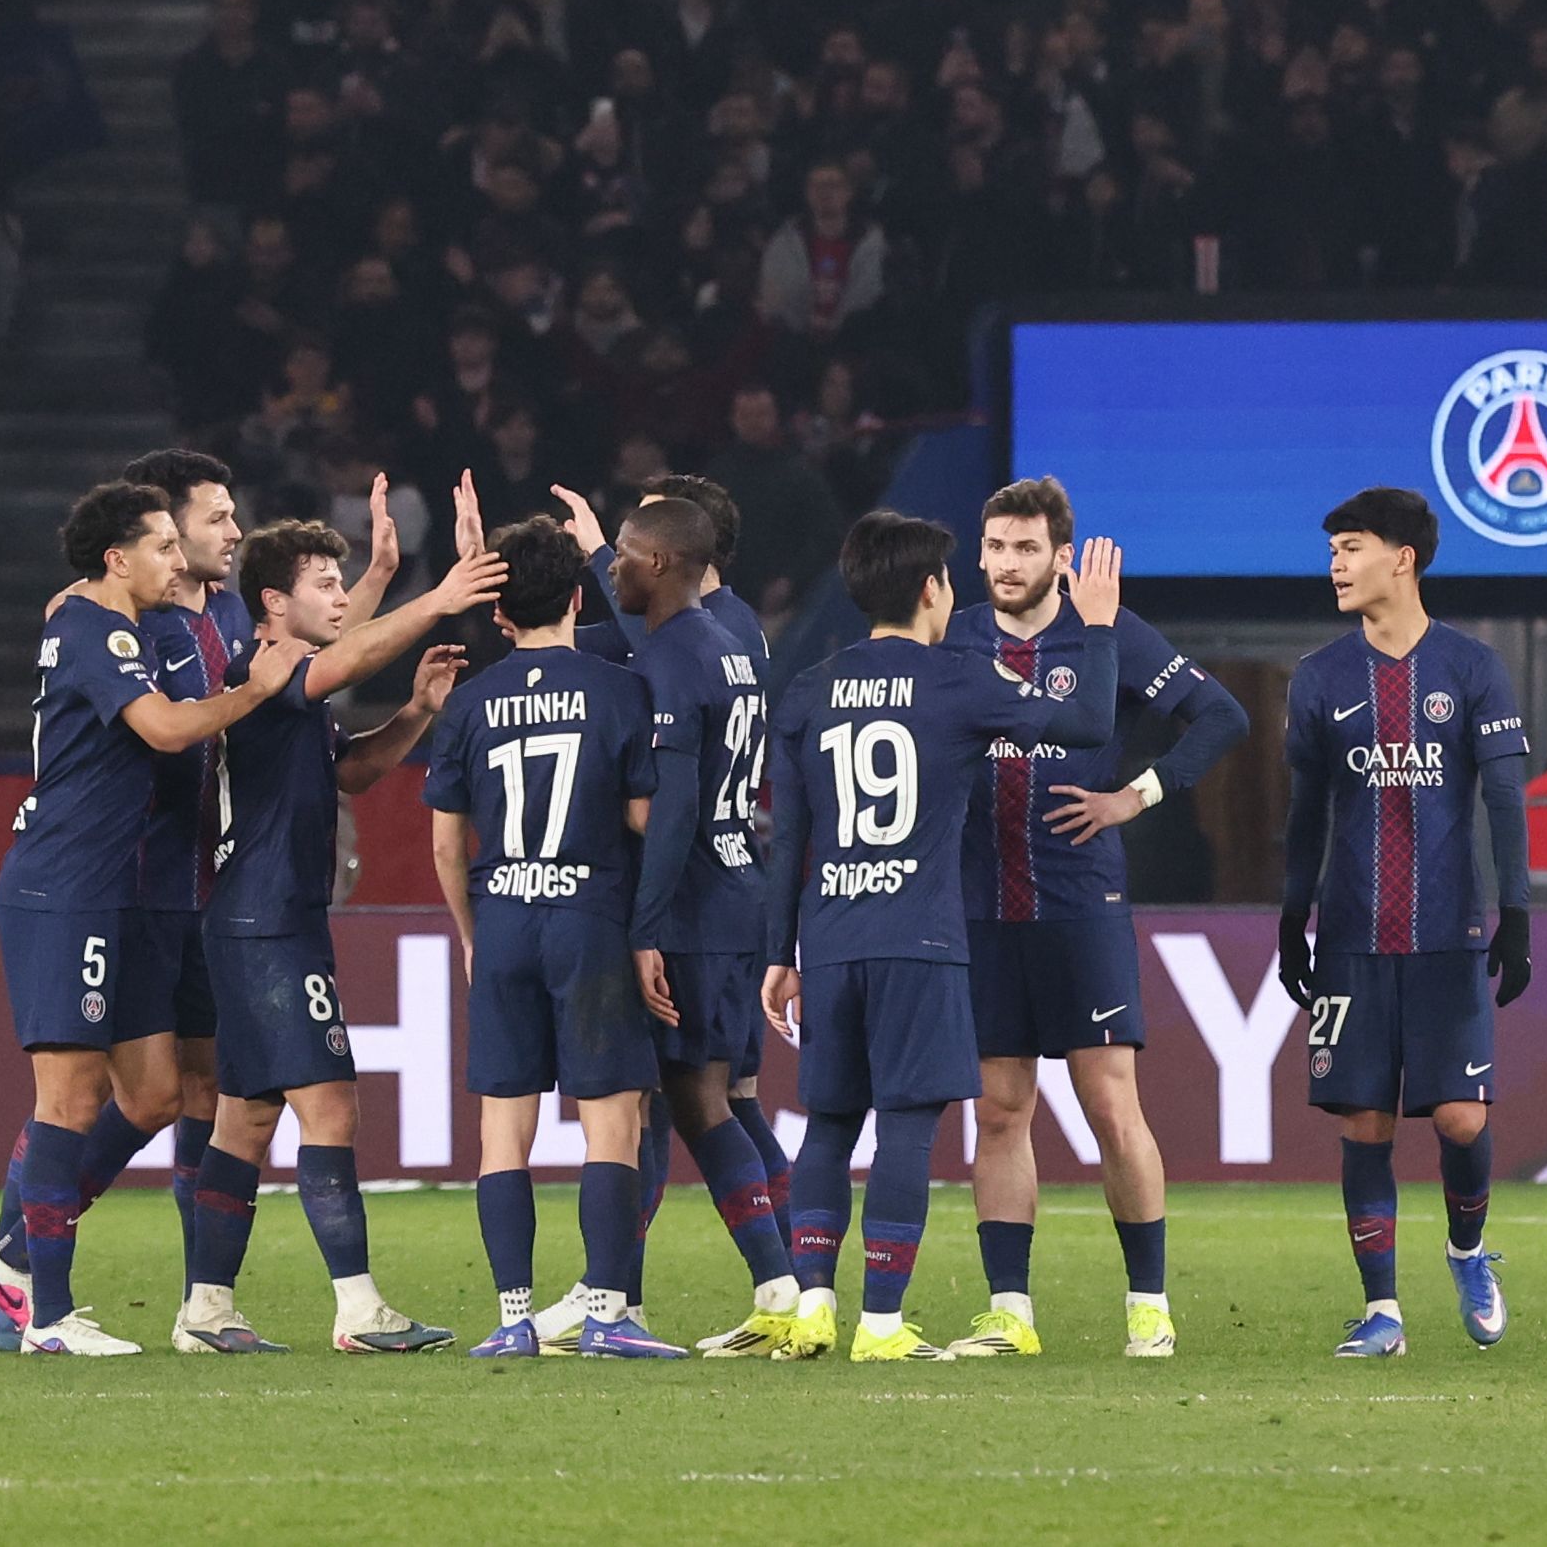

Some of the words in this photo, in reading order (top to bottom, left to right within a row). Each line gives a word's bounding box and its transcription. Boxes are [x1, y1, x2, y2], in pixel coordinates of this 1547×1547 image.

[485, 691, 587, 729] VITINHA
[831, 678, 887, 708] KANG
[889, 677, 914, 707] IN
[1346, 742, 1444, 776] QATAR
[1366, 769, 1444, 788] AIRWAYS
[487, 732, 582, 859] 17
[820, 720, 918, 848] 19
[487, 862, 578, 904] snipes
[820, 859, 903, 901] snipes
[81, 935, 106, 988] 5
[1308, 995, 1352, 1046] 27
